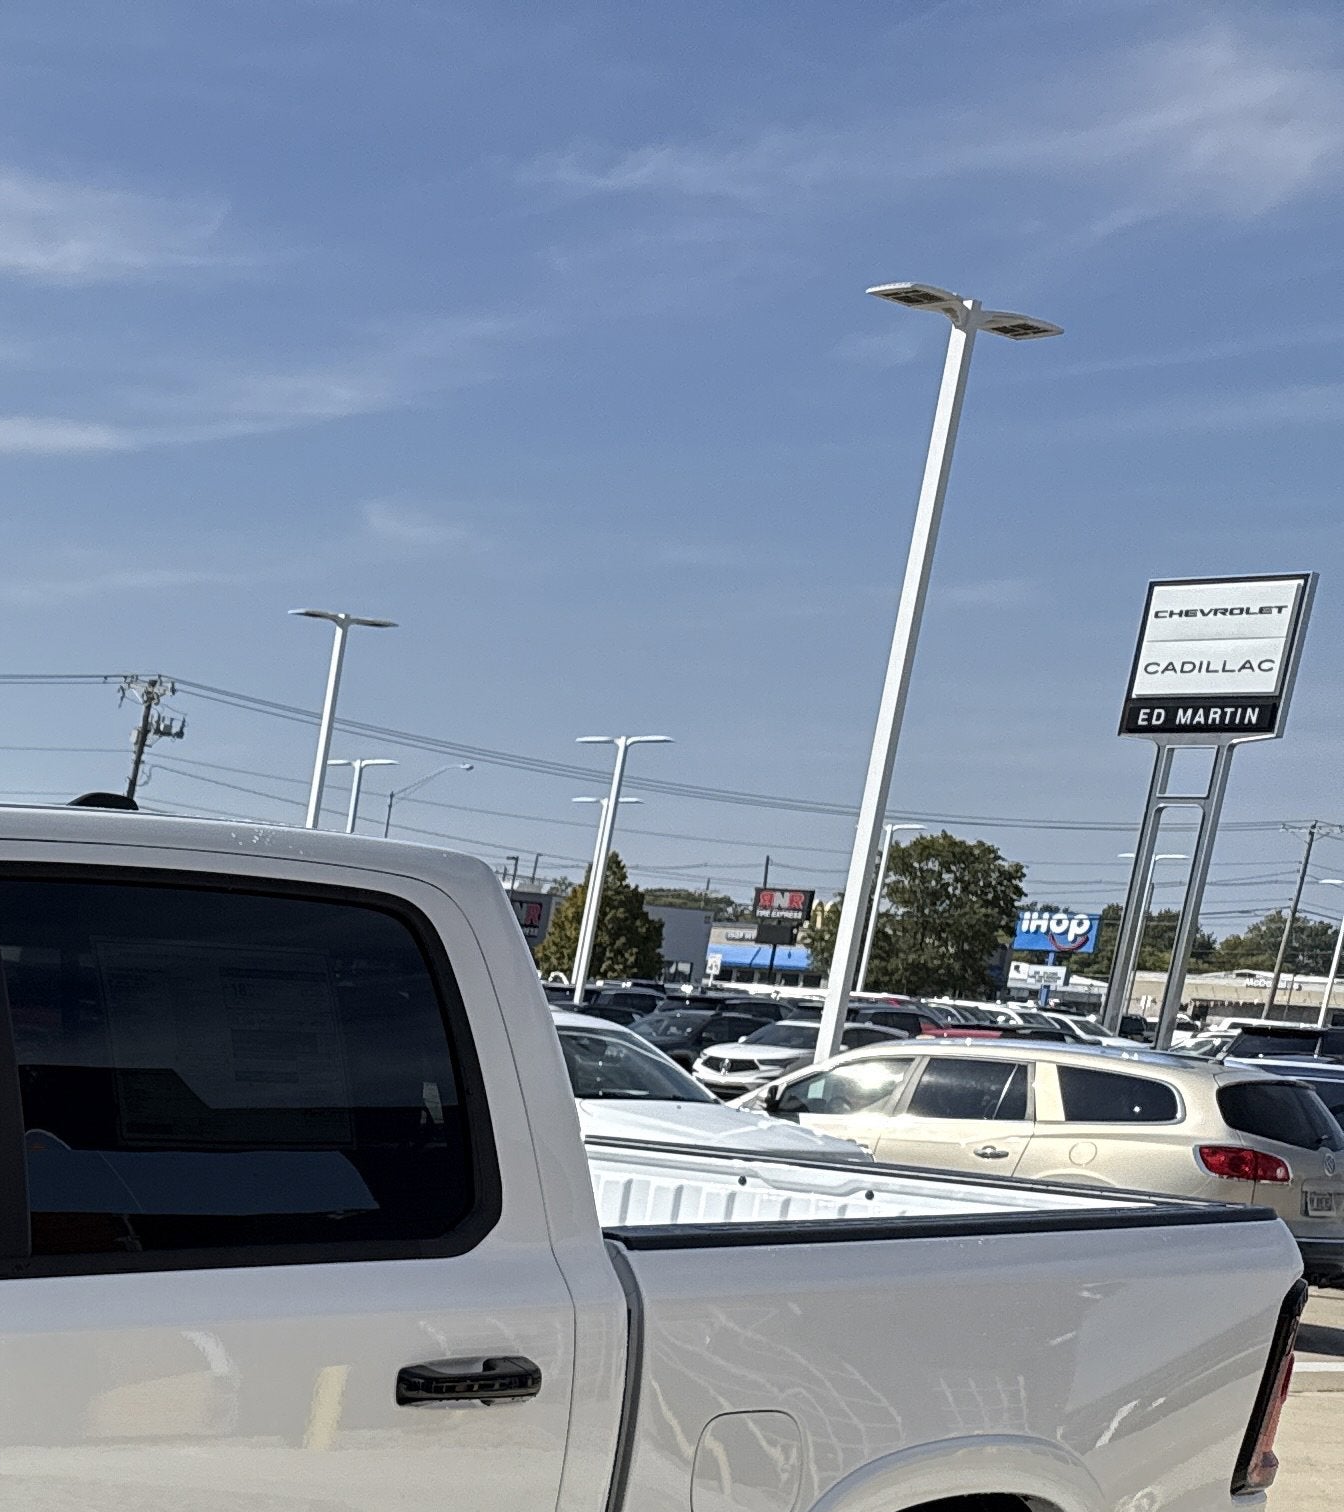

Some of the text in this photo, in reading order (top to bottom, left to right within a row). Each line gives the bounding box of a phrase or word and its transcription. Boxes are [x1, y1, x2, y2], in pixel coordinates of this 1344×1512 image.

[1153, 604, 1289, 619] CHEVROLET
[1143, 658, 1276, 675] CADILLAC
[1137, 706, 1260, 726] ED MARTIN
[1021, 911, 1091, 942] IHOP
